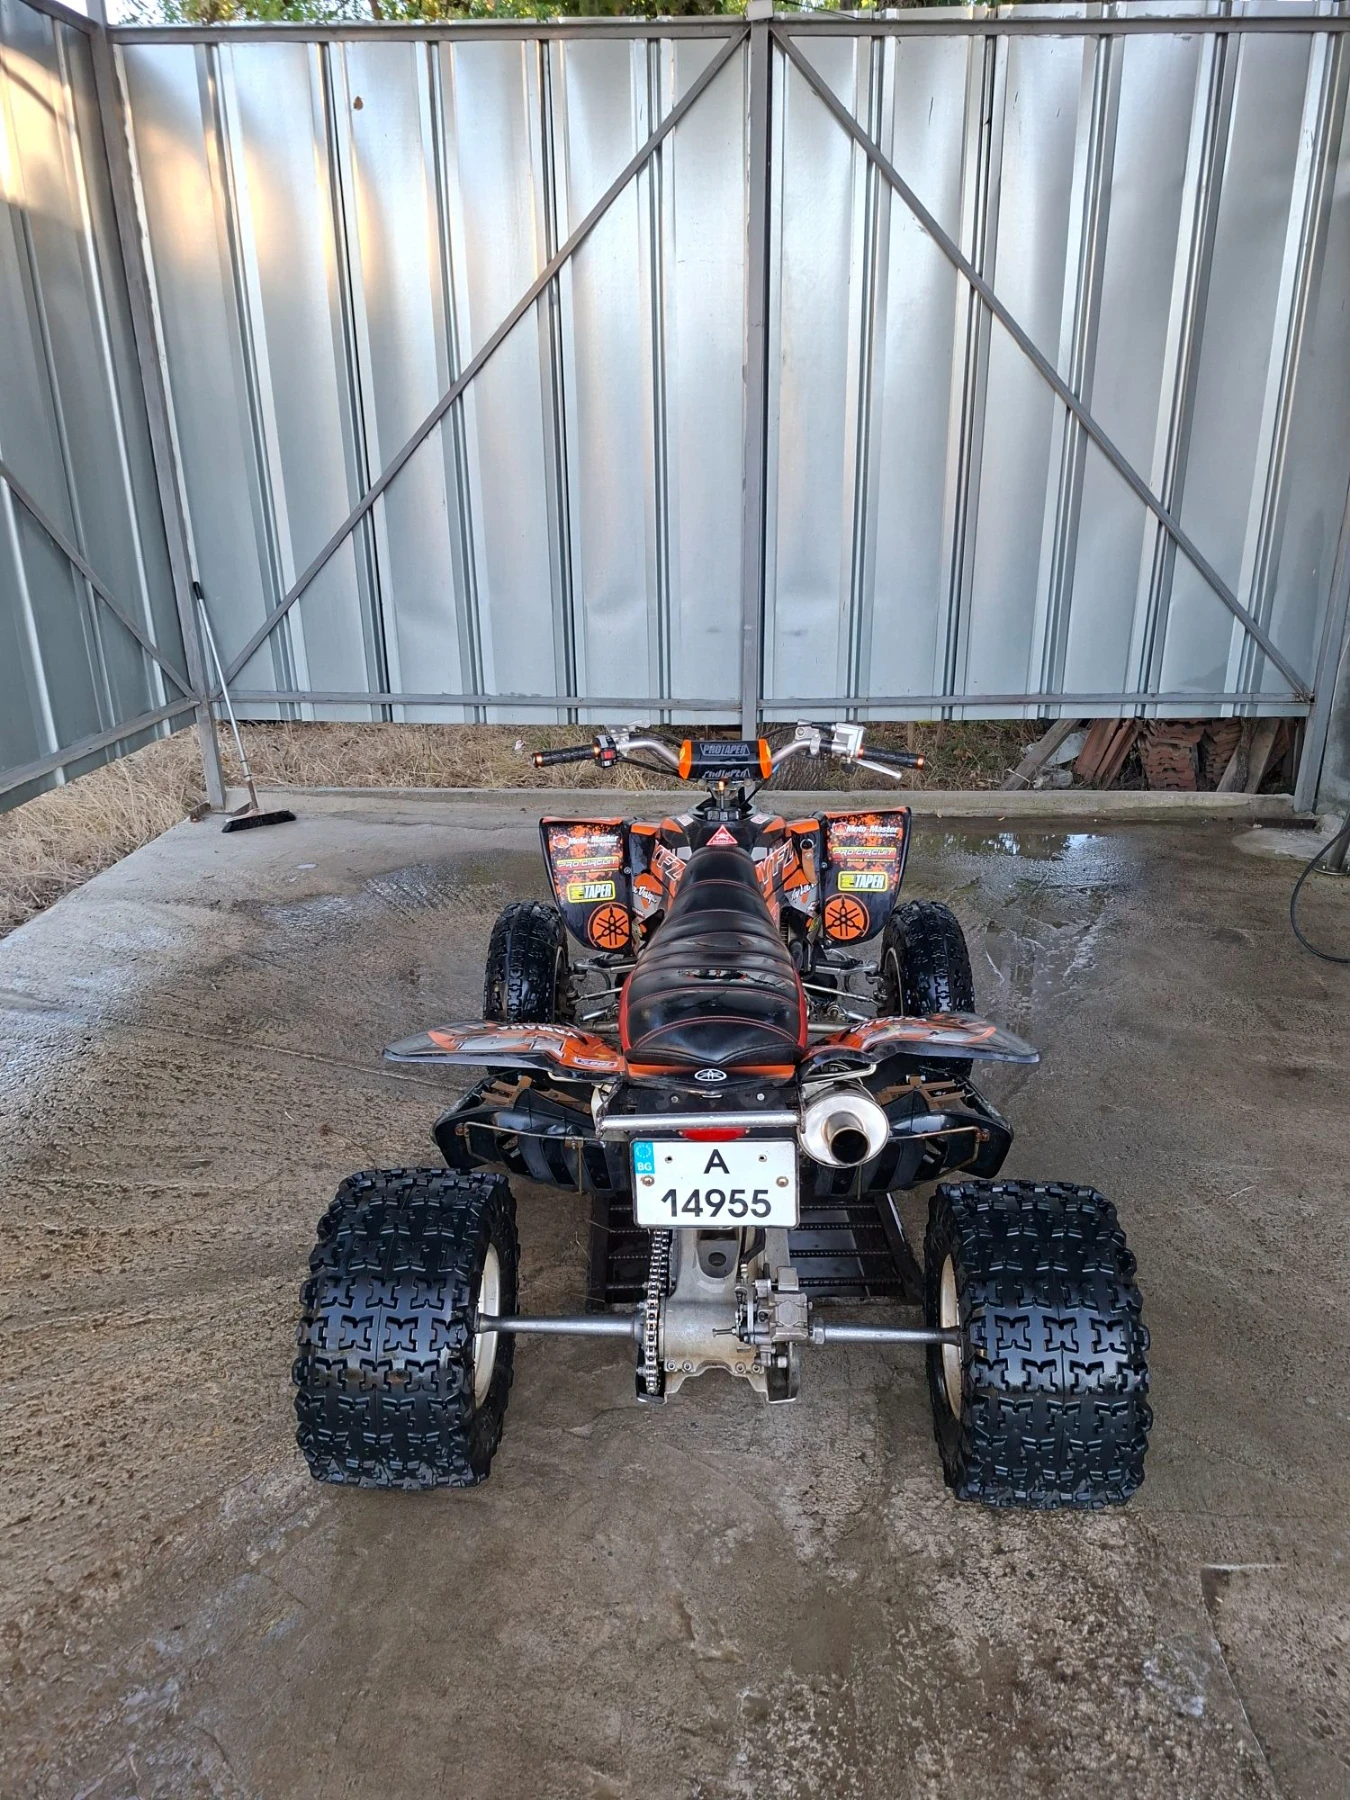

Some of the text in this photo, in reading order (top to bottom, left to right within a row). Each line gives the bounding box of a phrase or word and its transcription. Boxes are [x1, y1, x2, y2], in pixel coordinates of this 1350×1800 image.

[833, 848, 893, 857] PRO CIRCUIT
[558, 858, 617, 868] PRO CIRCUIT
[854, 874, 886, 889] TAPER
[583, 883, 612, 899] TAPER
[637, 1162, 653, 1171] BG
[703, 1148, 731, 1175] A
[660, 1188, 772, 1219] 14955
